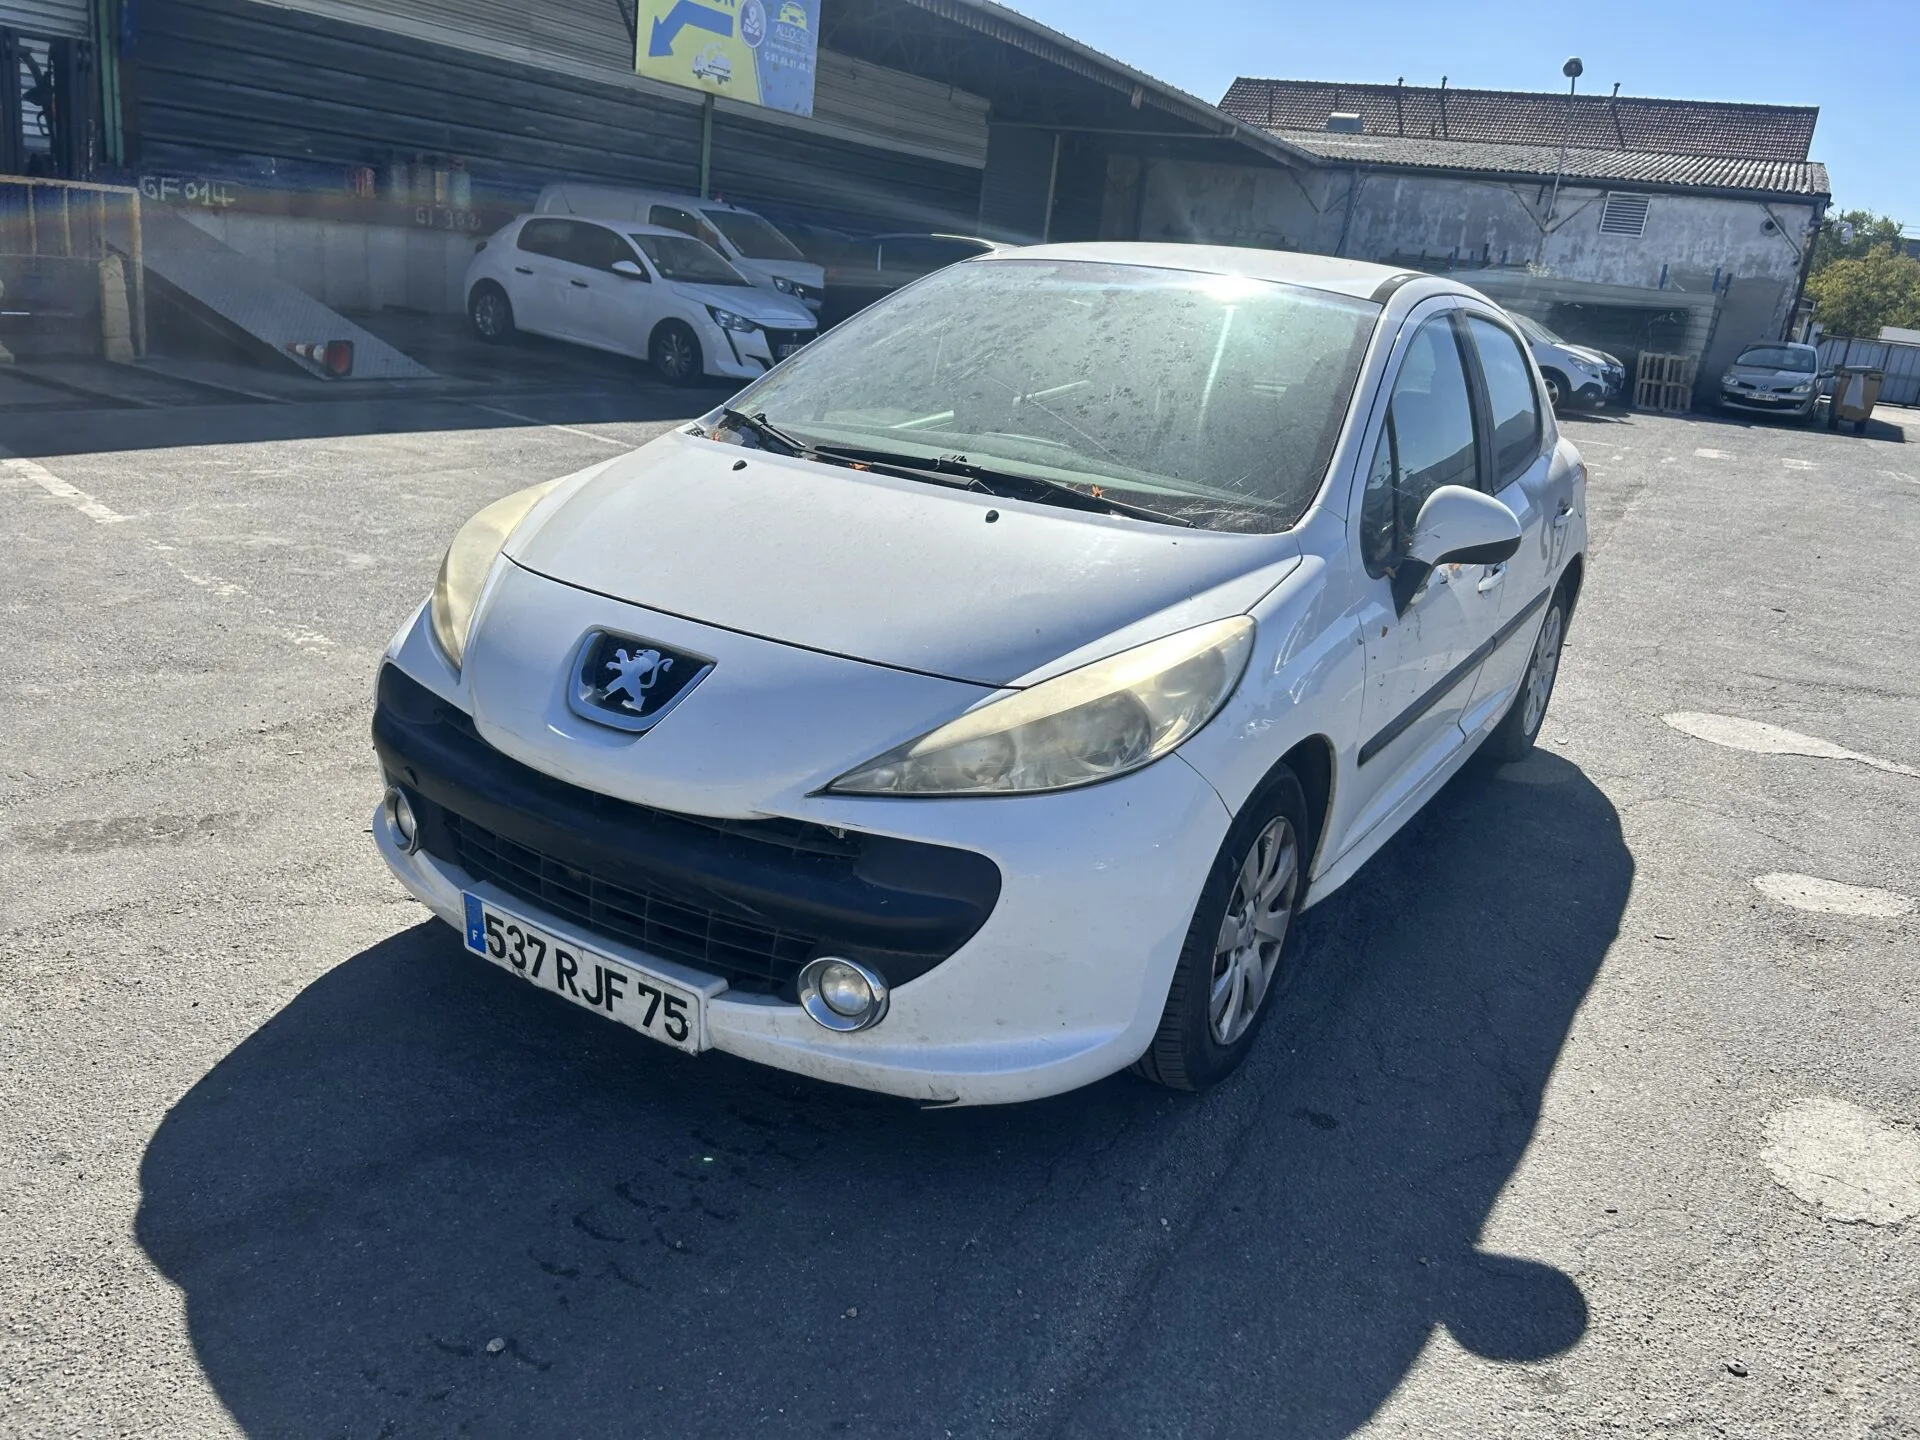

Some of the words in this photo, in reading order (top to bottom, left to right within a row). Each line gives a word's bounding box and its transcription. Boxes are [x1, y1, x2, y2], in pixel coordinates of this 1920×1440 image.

[139, 175, 179, 201] GF
[182, 180, 236, 206] 014
[472, 929, 478, 941] F
[484, 911, 547, 978] 537
[555, 948, 628, 1012] RJF
[638, 982, 689, 1042] 75
